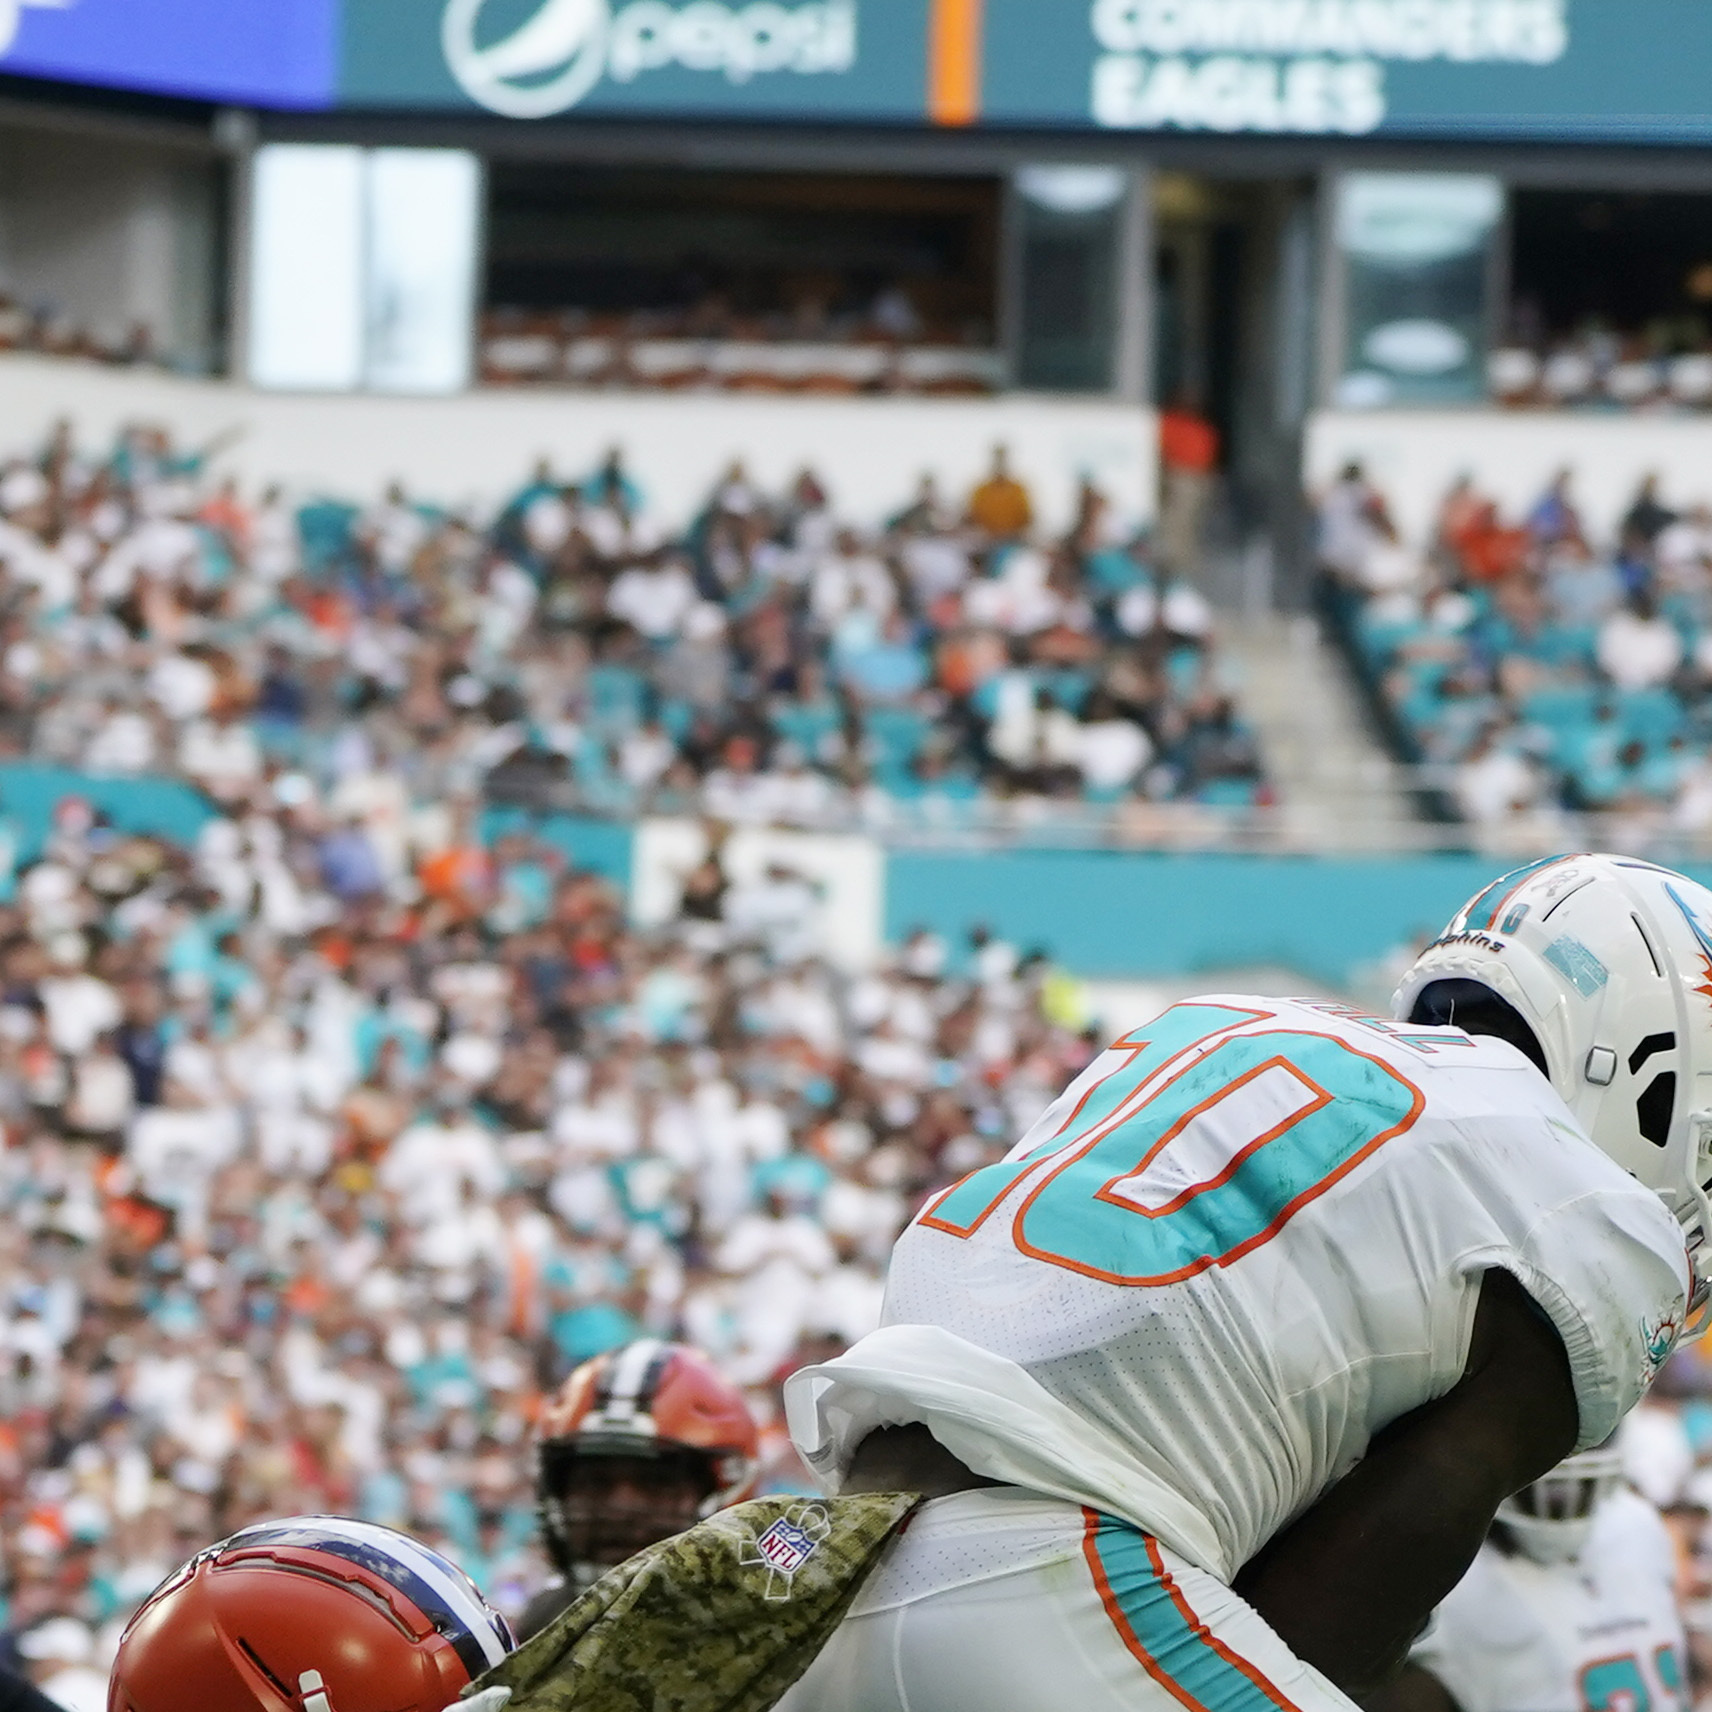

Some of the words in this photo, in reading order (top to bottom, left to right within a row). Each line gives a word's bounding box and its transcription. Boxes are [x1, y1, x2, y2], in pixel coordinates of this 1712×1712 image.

[610, 0, 856, 85] pepsi
[1093, 51, 1384, 133] EAGLES
[917, 1002, 1427, 1287] 10
[762, 1533, 798, 1569] NFL
